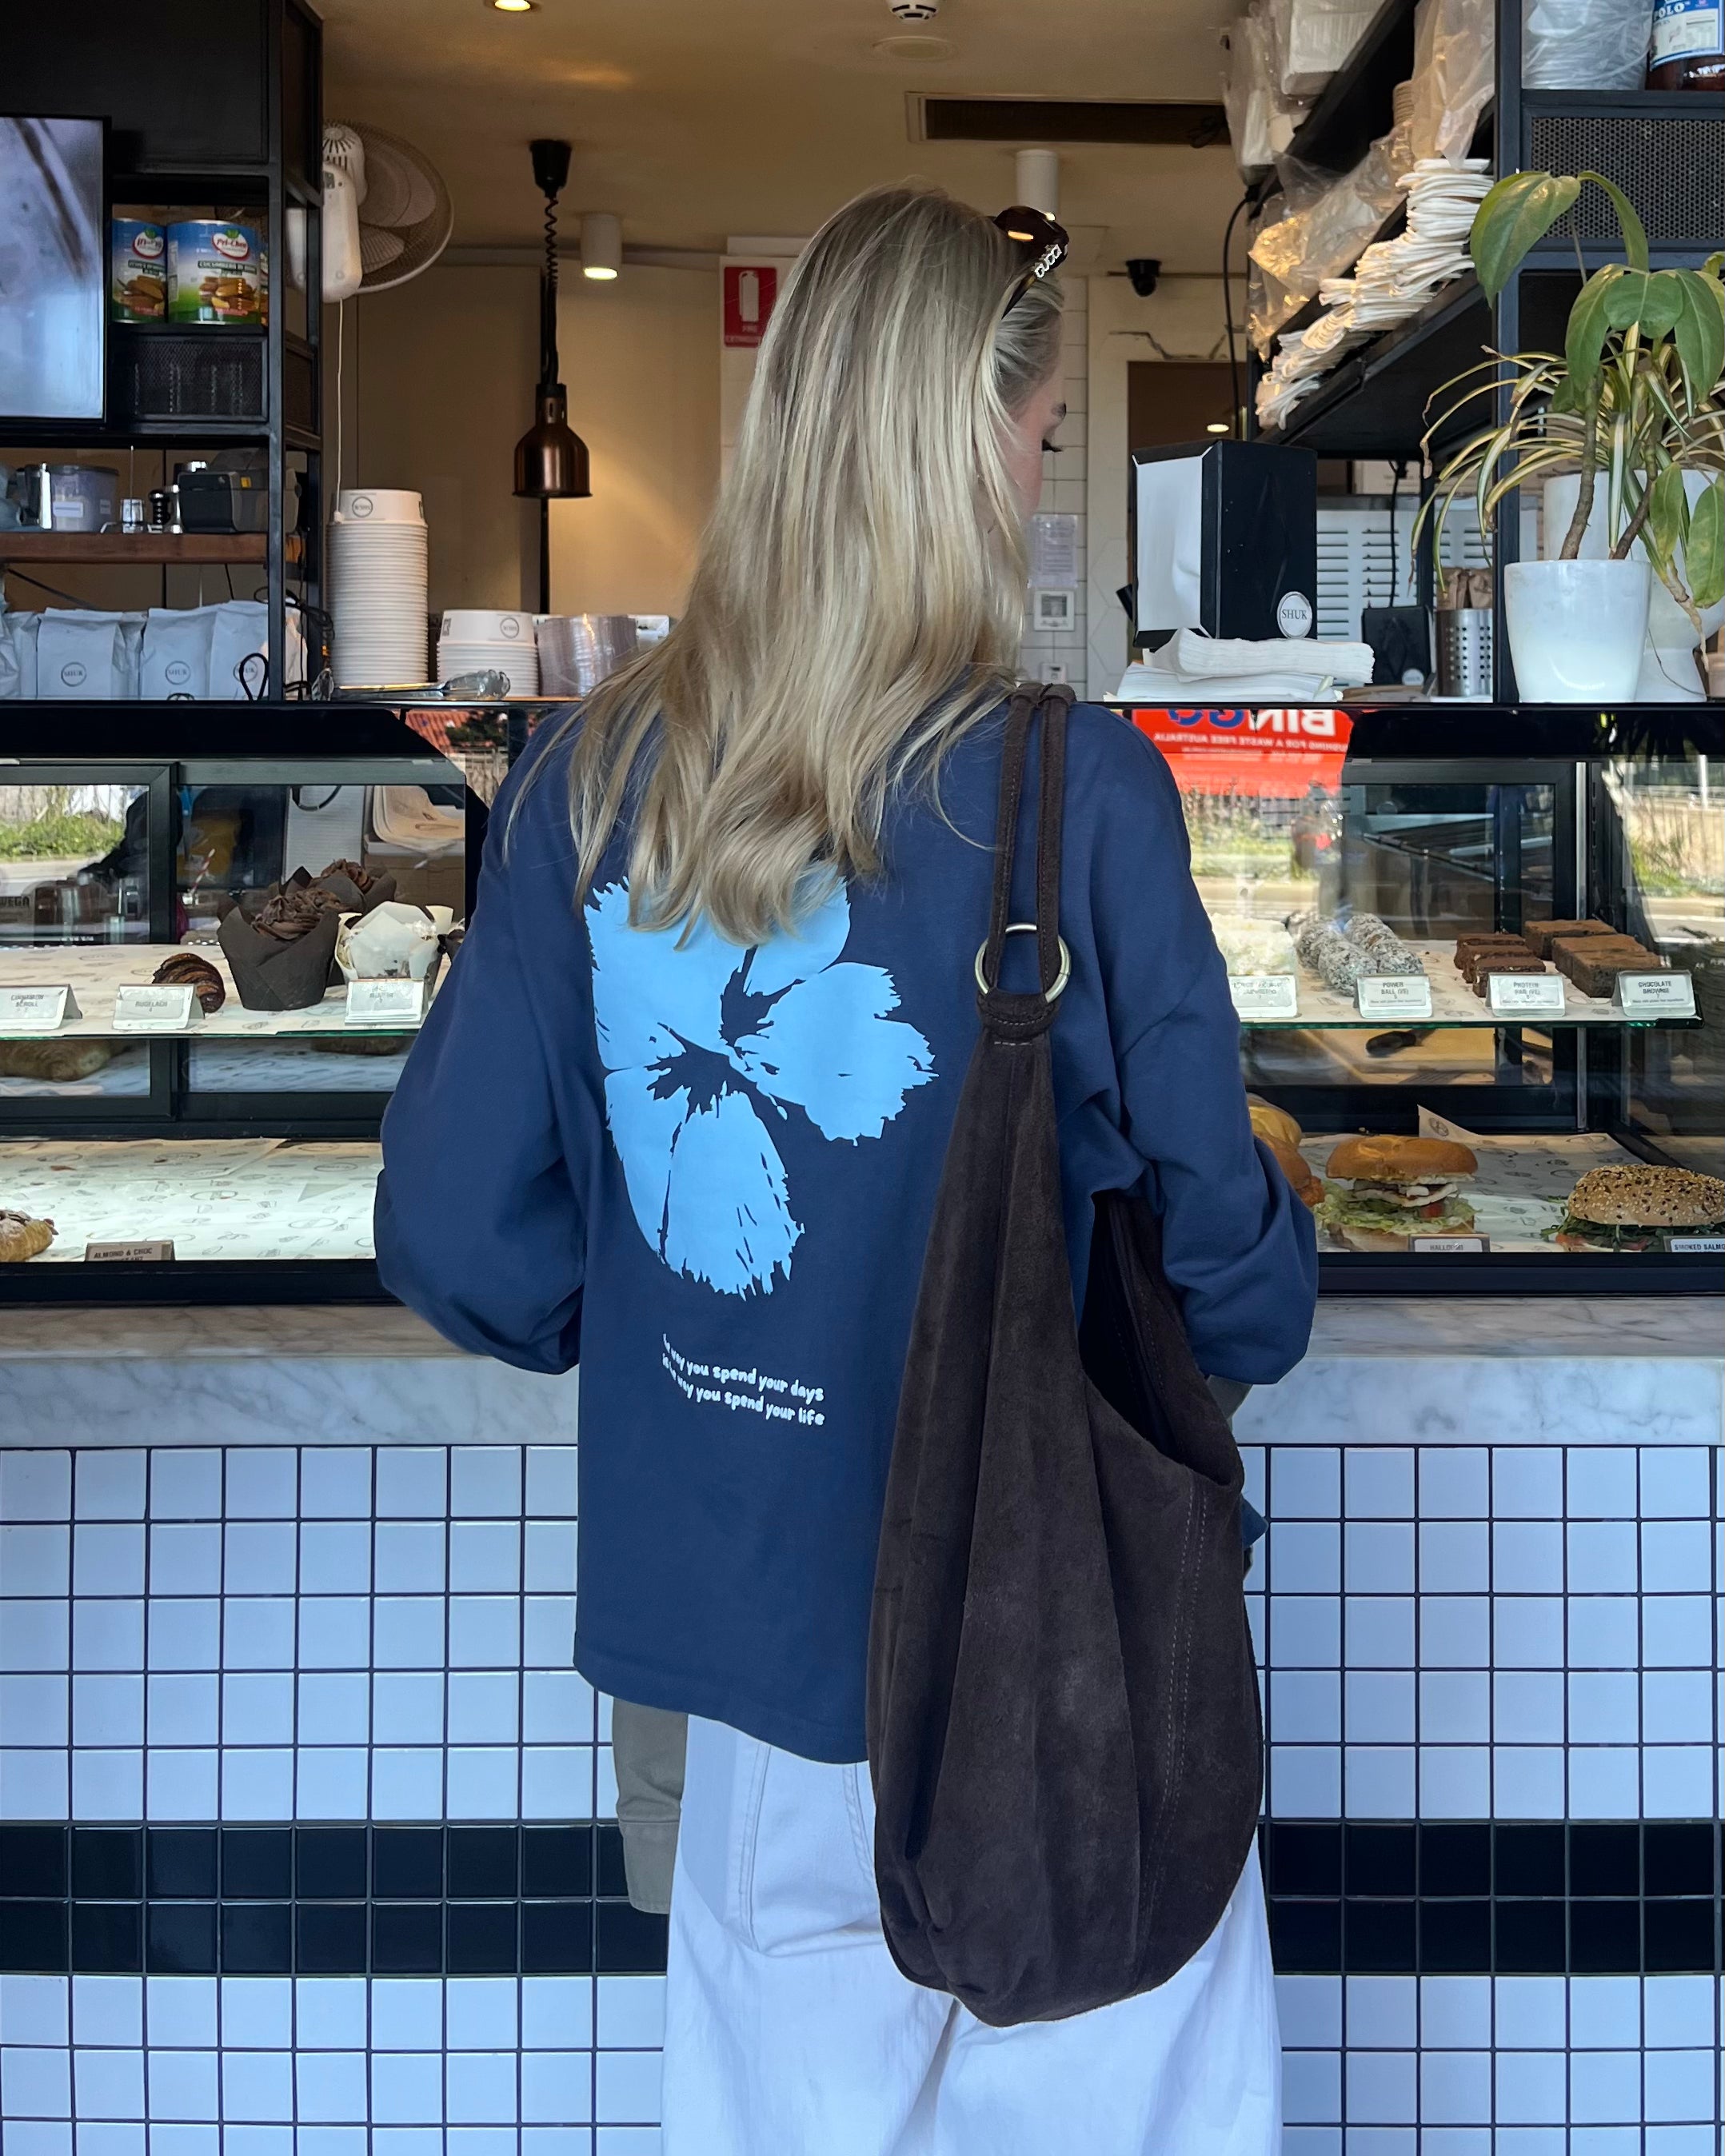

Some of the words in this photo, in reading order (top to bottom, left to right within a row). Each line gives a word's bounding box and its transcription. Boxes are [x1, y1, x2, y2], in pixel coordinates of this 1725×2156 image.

[1281, 609, 1308, 620] SHUK
[94, 1250, 125, 1259] ALMOND
[686, 1360, 709, 1376] you
[713, 1366, 757, 1383] spend
[758, 1375, 789, 1392] your
[790, 1379, 825, 1405] days
[696, 1387, 721, 1403] you
[724, 1391, 764, 1411] spend
[765, 1403, 796, 1420] your
[798, 1407, 825, 1425] life
